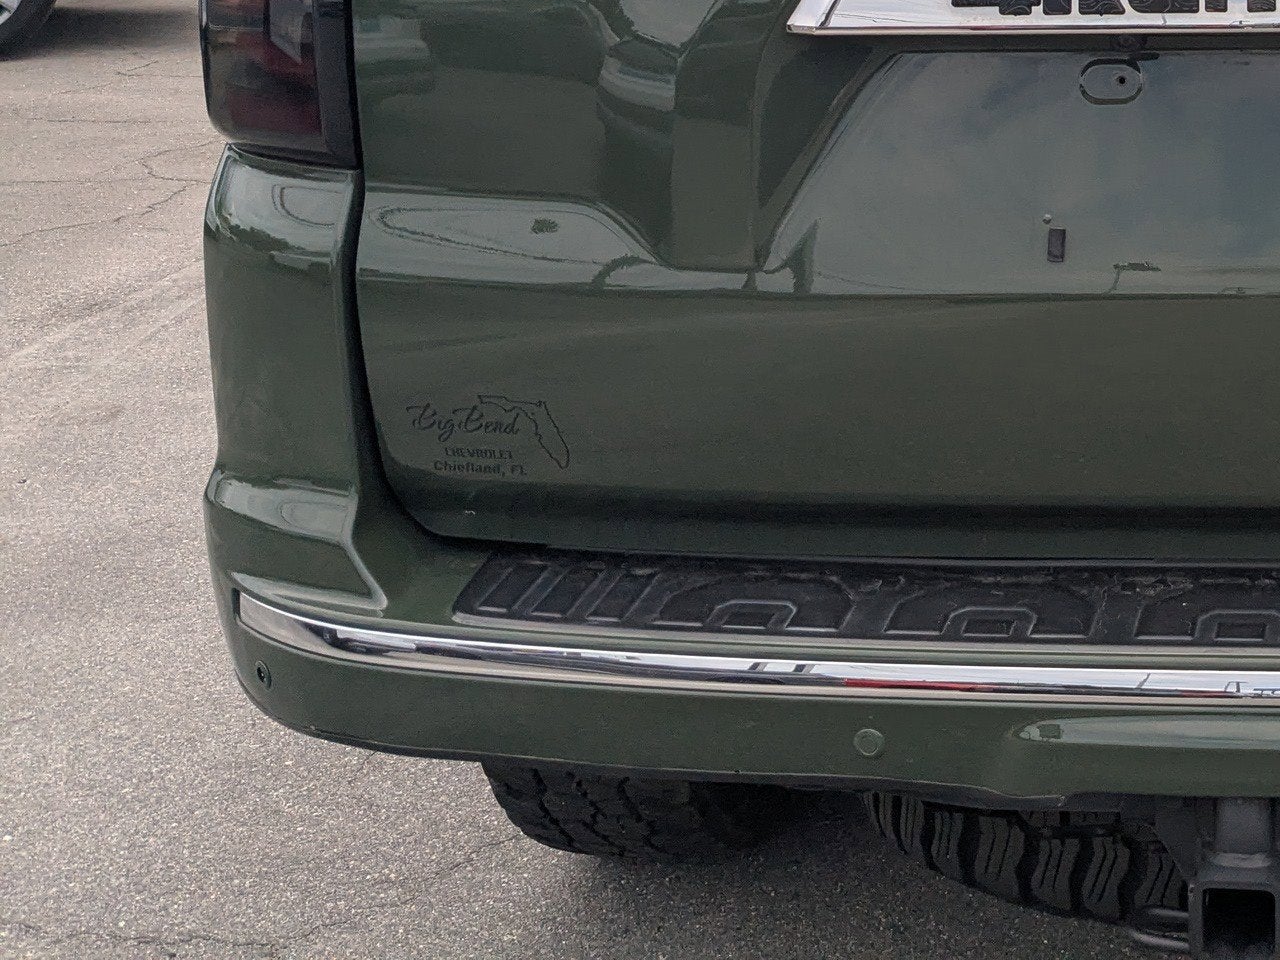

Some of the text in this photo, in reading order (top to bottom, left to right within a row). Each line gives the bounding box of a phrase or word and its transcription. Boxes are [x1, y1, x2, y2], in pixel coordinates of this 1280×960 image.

[406, 403, 520, 442] Big Bend
[444, 447, 514, 460] CHEVROLET
[433, 460, 527, 477] Chiefland, FL
